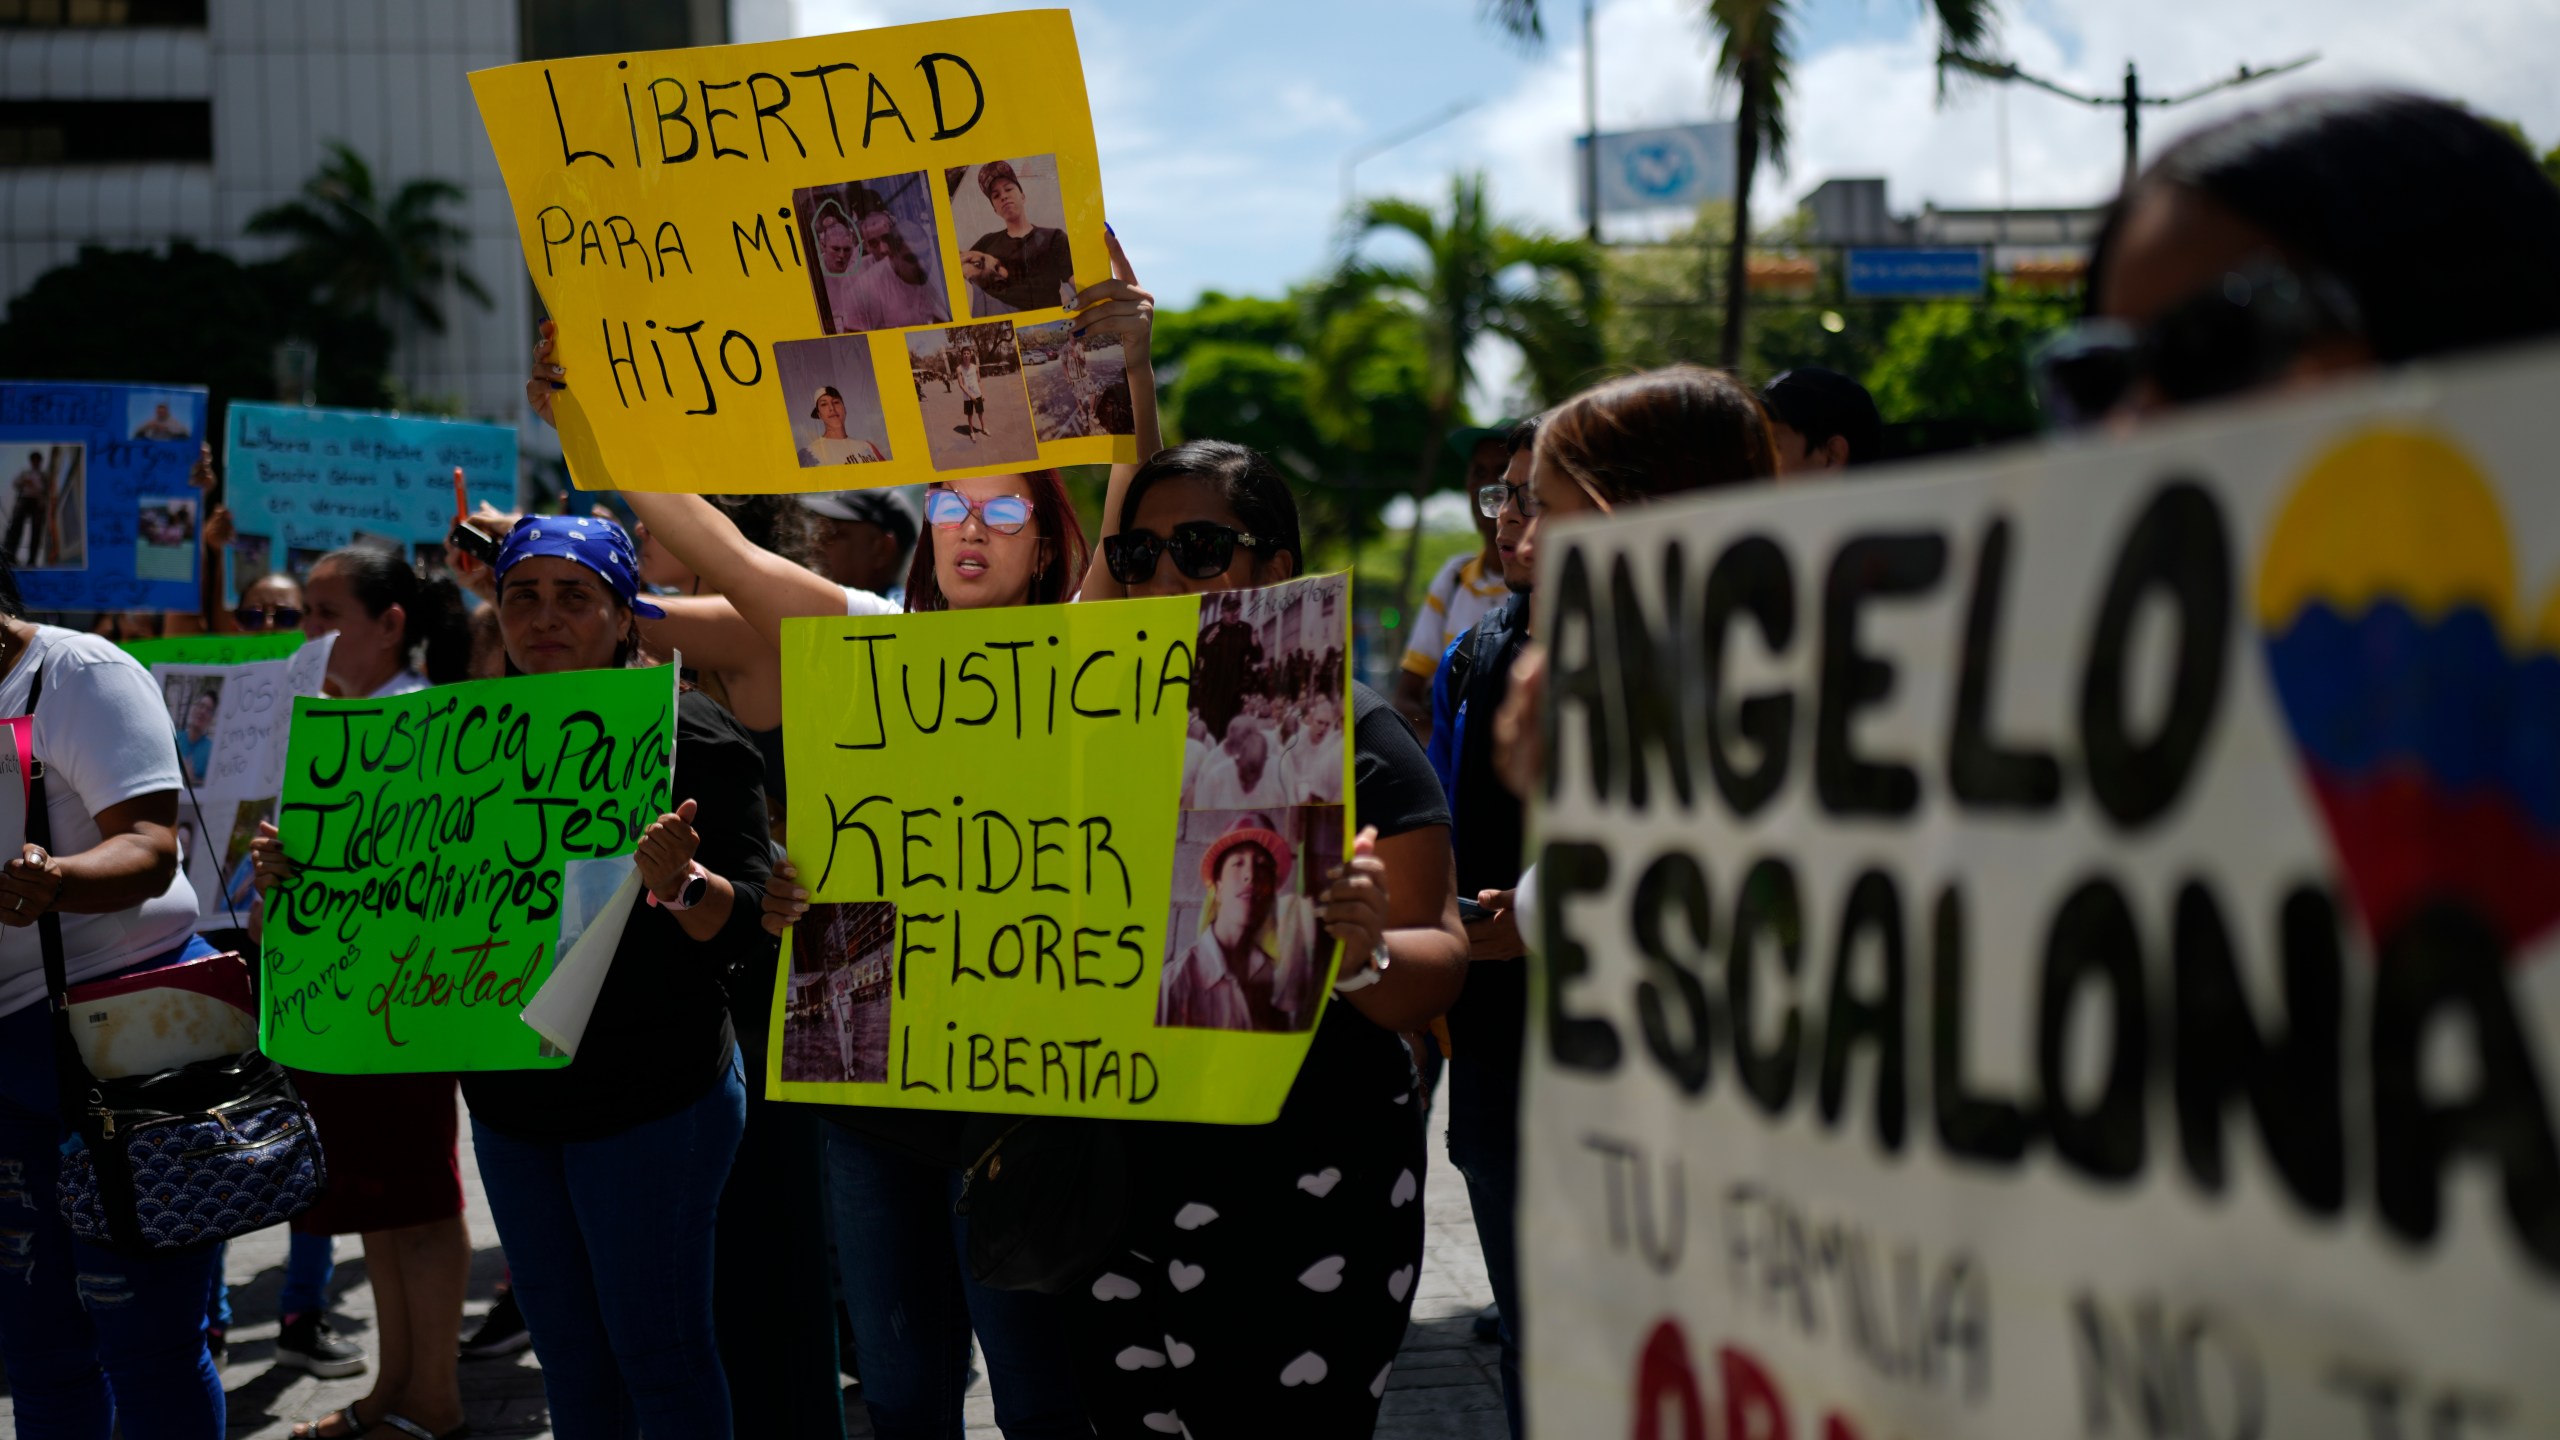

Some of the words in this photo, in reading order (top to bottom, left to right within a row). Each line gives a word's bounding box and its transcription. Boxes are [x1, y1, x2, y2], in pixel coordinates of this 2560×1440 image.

[536, 204, 694, 284] PARA
[1545, 472, 2236, 836] ANGELO
[305, 696, 546, 792] Justicia
[547, 703, 671, 793] Para
[266, 864, 408, 944] Romero
[897, 910, 1147, 1001] FLORES
[367, 934, 545, 1047] Libertad
[1540, 838, 2560, 1292] ESCALONA
[1578, 1131, 1688, 1279] TU
